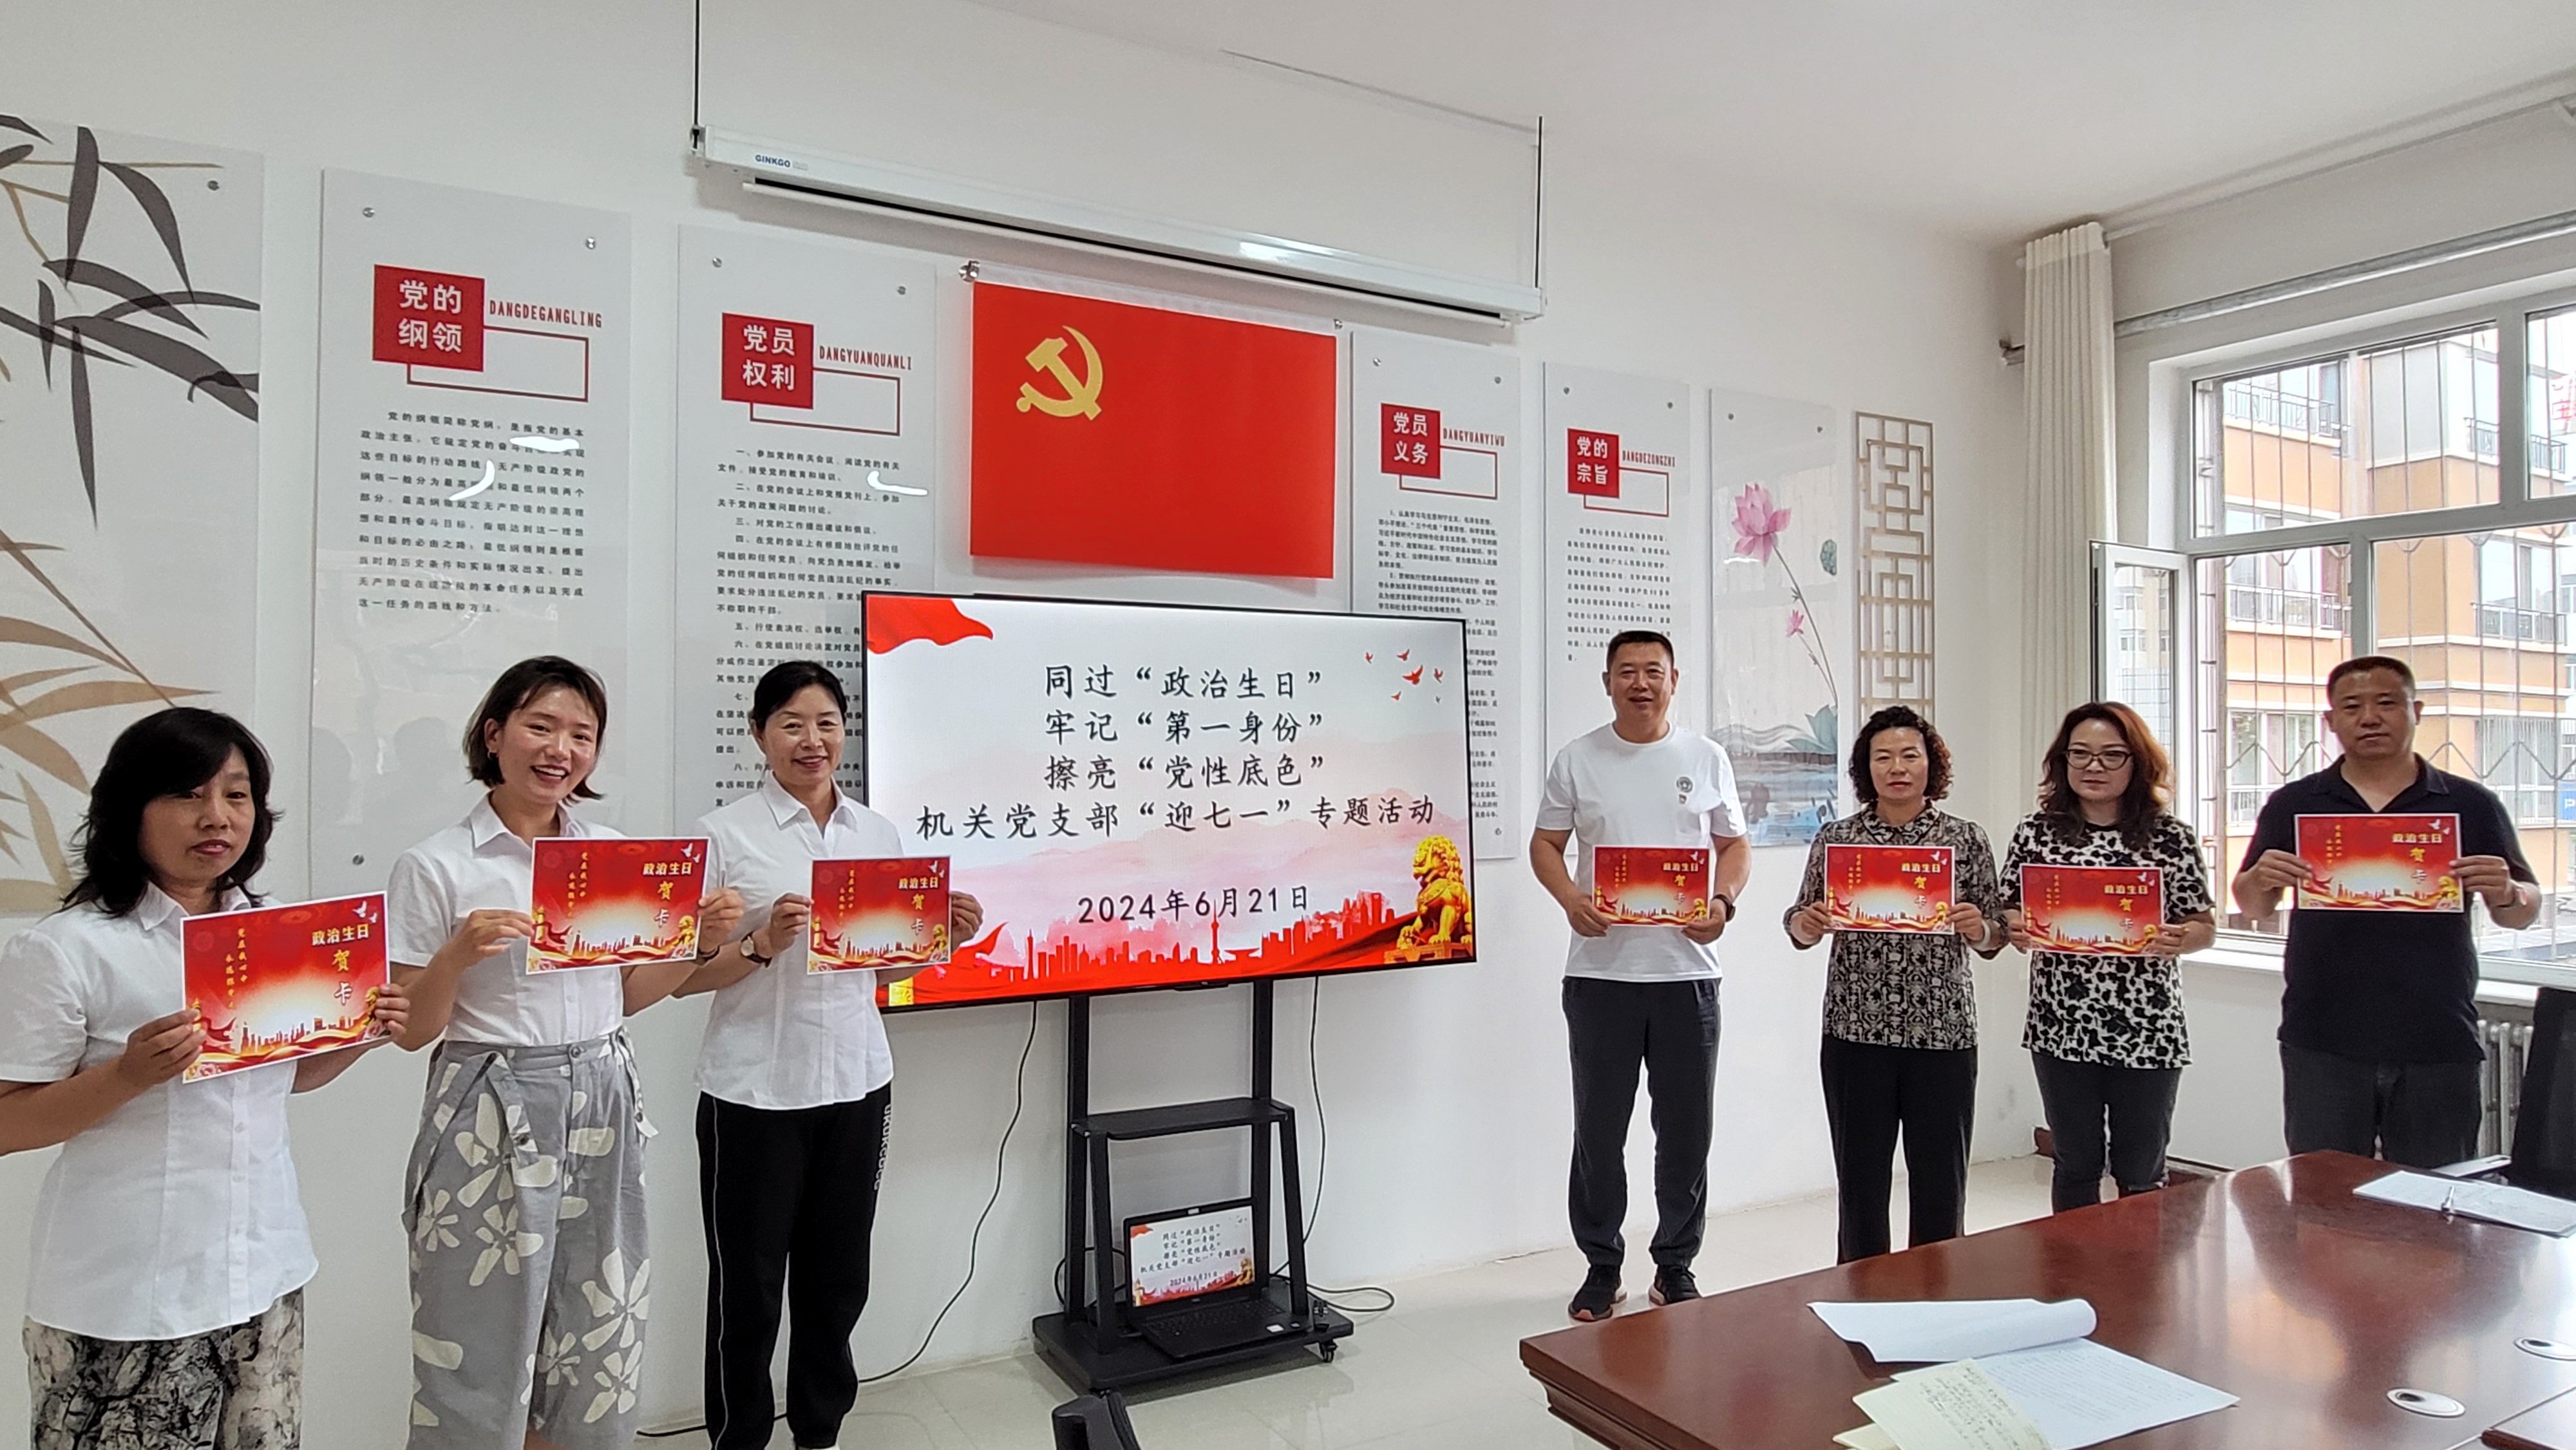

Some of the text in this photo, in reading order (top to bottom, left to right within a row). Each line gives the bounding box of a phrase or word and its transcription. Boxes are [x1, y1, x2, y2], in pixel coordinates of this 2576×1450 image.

[755, 155, 791, 167] GINKGO
[399, 279, 462, 314] 党的
[489, 300, 602, 328] DANGDEGANGLING
[398, 317, 462, 353] 纲领
[743, 324, 795, 356] 党员
[819, 345, 912, 370] DANGYUANQUANLI
[743, 359, 795, 391] 权利
[1393, 411, 1428, 437] 党员
[1443, 428, 1505, 447] DANGYUANYIWU
[1577, 436, 1607, 459] 党的
[1394, 440, 1428, 465] 义务
[1622, 450, 1676, 467] DANGDEZONGZHI
[1577, 462, 1608, 485] 宗旨
[1045, 664, 1321, 699] 同过“政治生日”
[1045, 709, 1322, 745] 牢记“第一身份”
[1044, 753, 1323, 791] 擦亮“党性底色”
[916, 795, 1434, 841] 机关党支部“迎七一”专题活动
[2392, 833, 2442, 843] 政治生日
[643, 862, 692, 876] 政治生日
[1901, 863, 1941, 873] 政治生日
[898, 877, 938, 889] 政治生日
[2104, 885, 2148, 894] 政治生日
[1078, 885, 1308, 923] 2024年6月21日
[1915, 895, 1927, 909] 卡
[654, 909, 670, 928] 卡
[912, 918, 923, 935] 卡
[312, 923, 369, 946] 政治生日
[334, 983, 352, 1005] 卡
